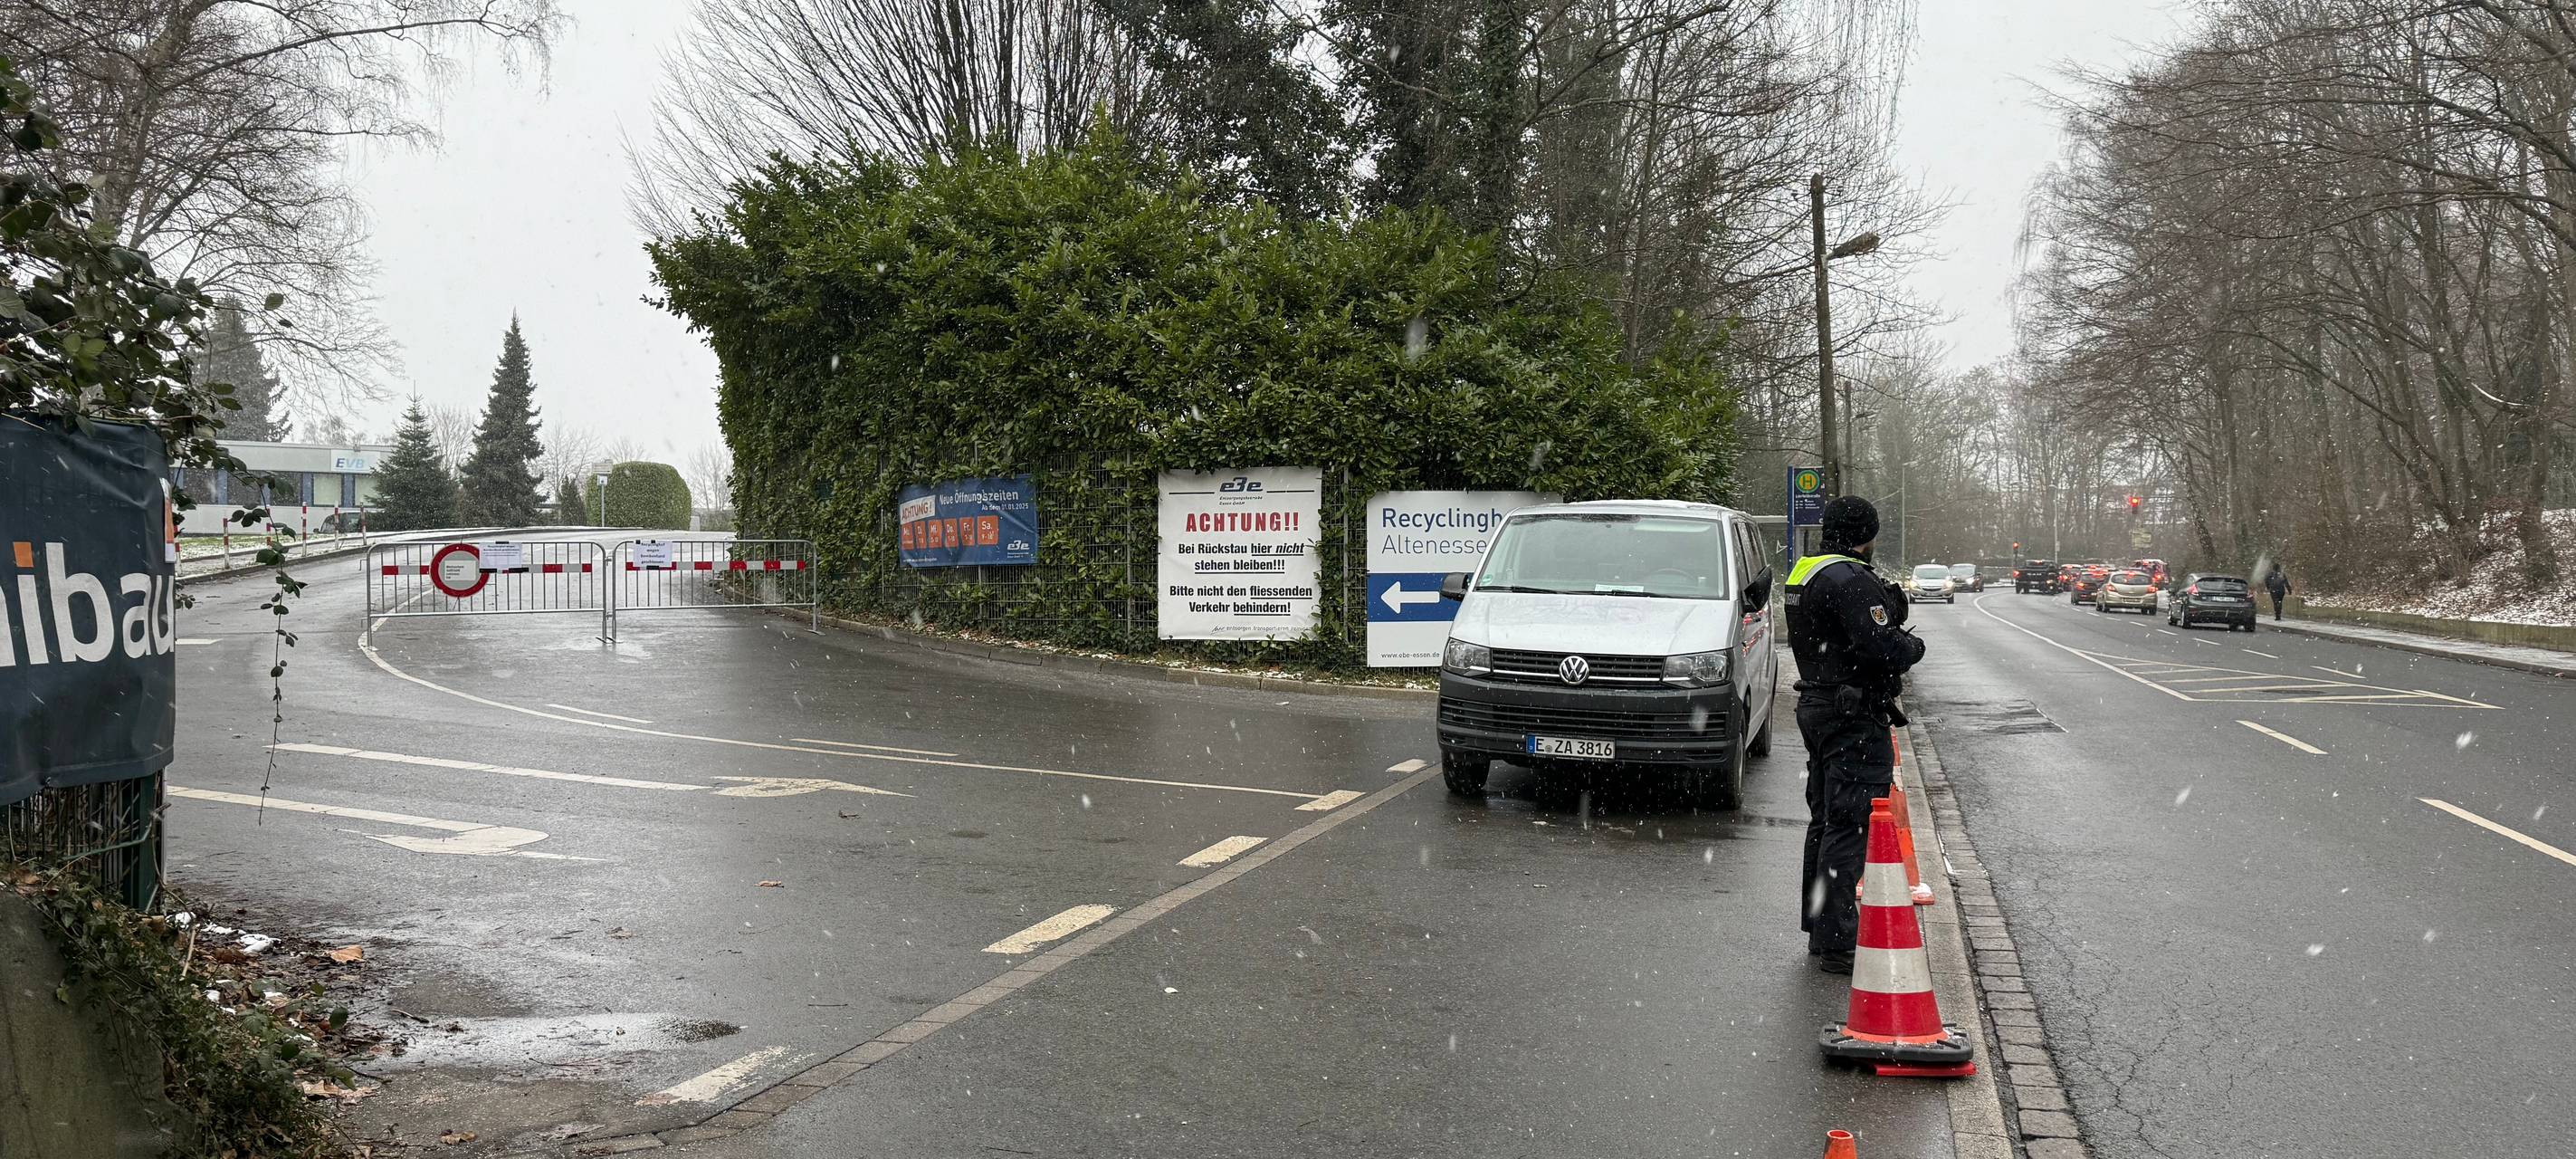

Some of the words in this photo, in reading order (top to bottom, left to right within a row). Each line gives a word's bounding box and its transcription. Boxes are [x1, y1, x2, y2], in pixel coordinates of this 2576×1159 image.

[336, 457, 365, 469] EVB
[940, 493, 953, 505] Neue
[955, 490, 1019, 503] Öffnungszeiten
[981, 521, 993, 530] Sa.
[1186, 512, 1299, 532] ACHTUNG!!
[1178, 544, 1195, 554] Bei
[1197, 543, 1248, 554] Rückstau
[1251, 543, 1273, 554] hier
[1275, 543, 1304, 554] nicht
[1194, 560, 1230, 570] stehen
[1233, 560, 1285, 570] bleiben!!!
[1169, 586, 1194, 597] Bitte
[1197, 586, 1224, 597] nicht
[1226, 586, 1246, 597] den
[1250, 586, 1312, 597] fliessenden
[1188, 602, 1230, 613] Verkehr
[1234, 602, 1291, 613] behindern!
[1536, 738, 1545, 752] E
[1555, 740, 1572, 753] ZA
[1577, 742, 1613, 756] 3816
